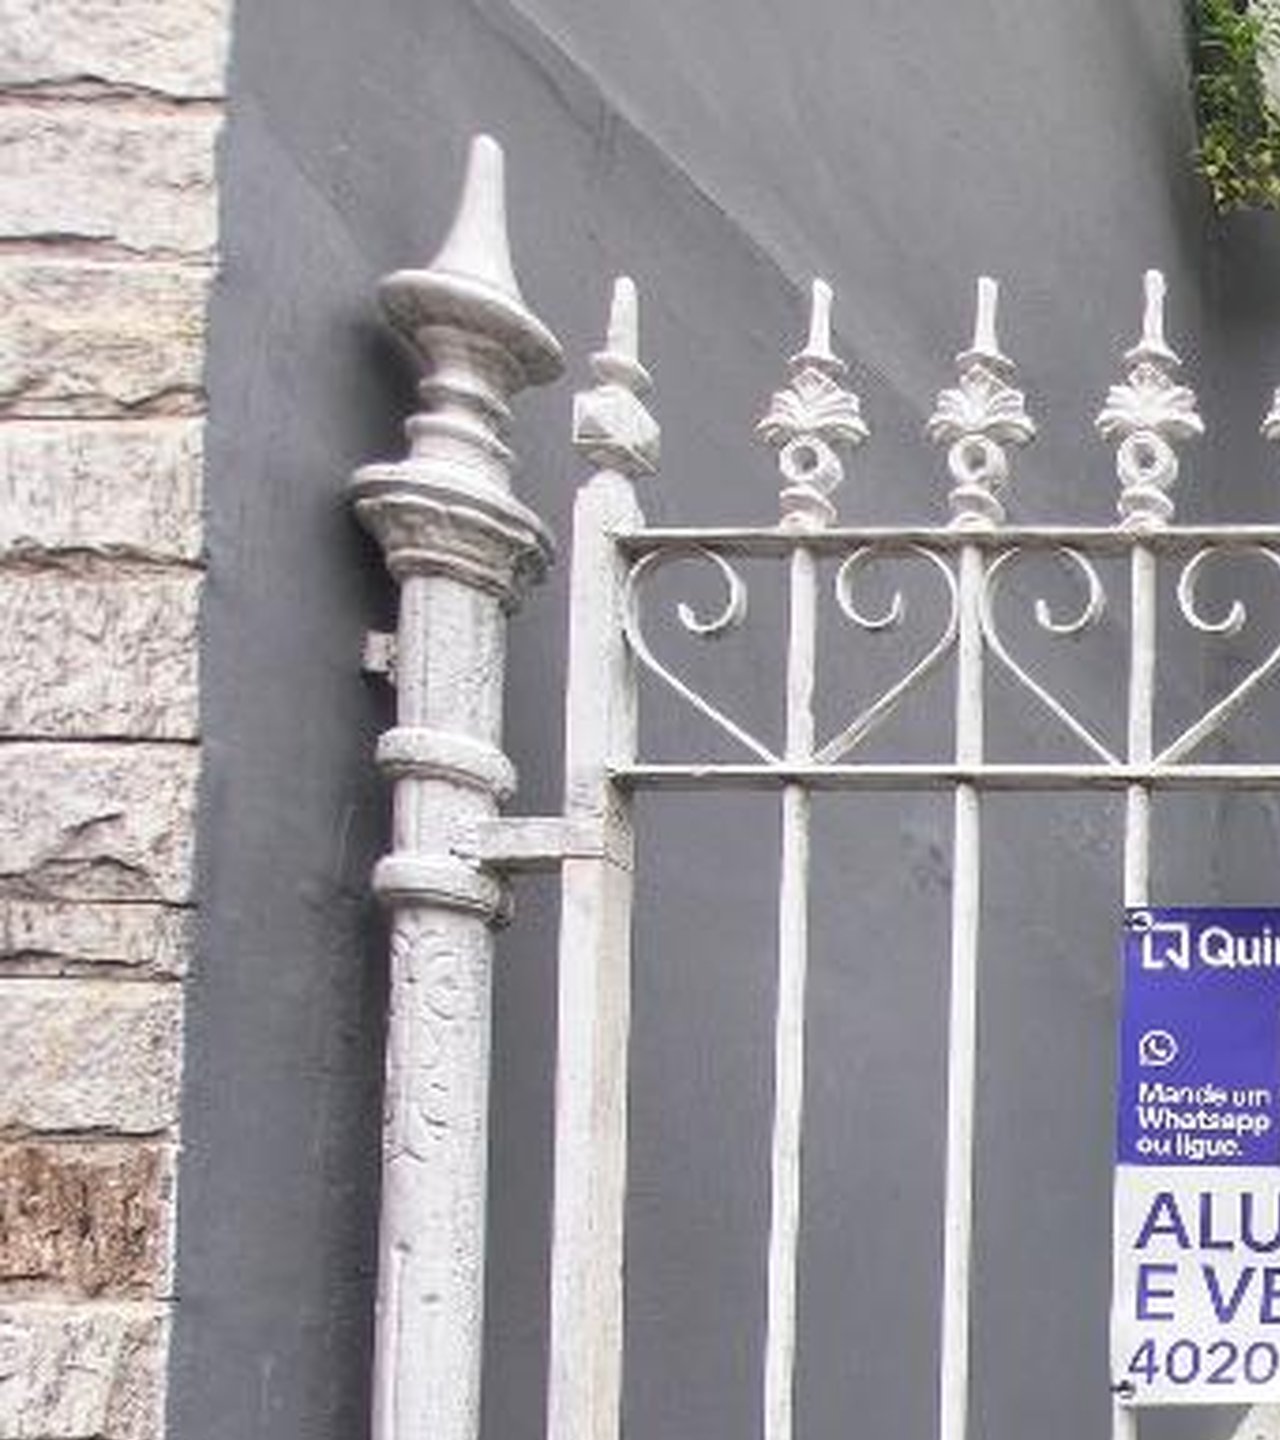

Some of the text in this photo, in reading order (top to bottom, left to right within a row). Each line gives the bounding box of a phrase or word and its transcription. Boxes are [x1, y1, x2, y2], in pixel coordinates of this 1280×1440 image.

[1138, 1083, 1272, 1107] Mande um
[1136, 1105, 1271, 1136] Whatsapp
[1136, 1133, 1243, 1159] ou ligue.
[1135, 1264, 1178, 1321] E
